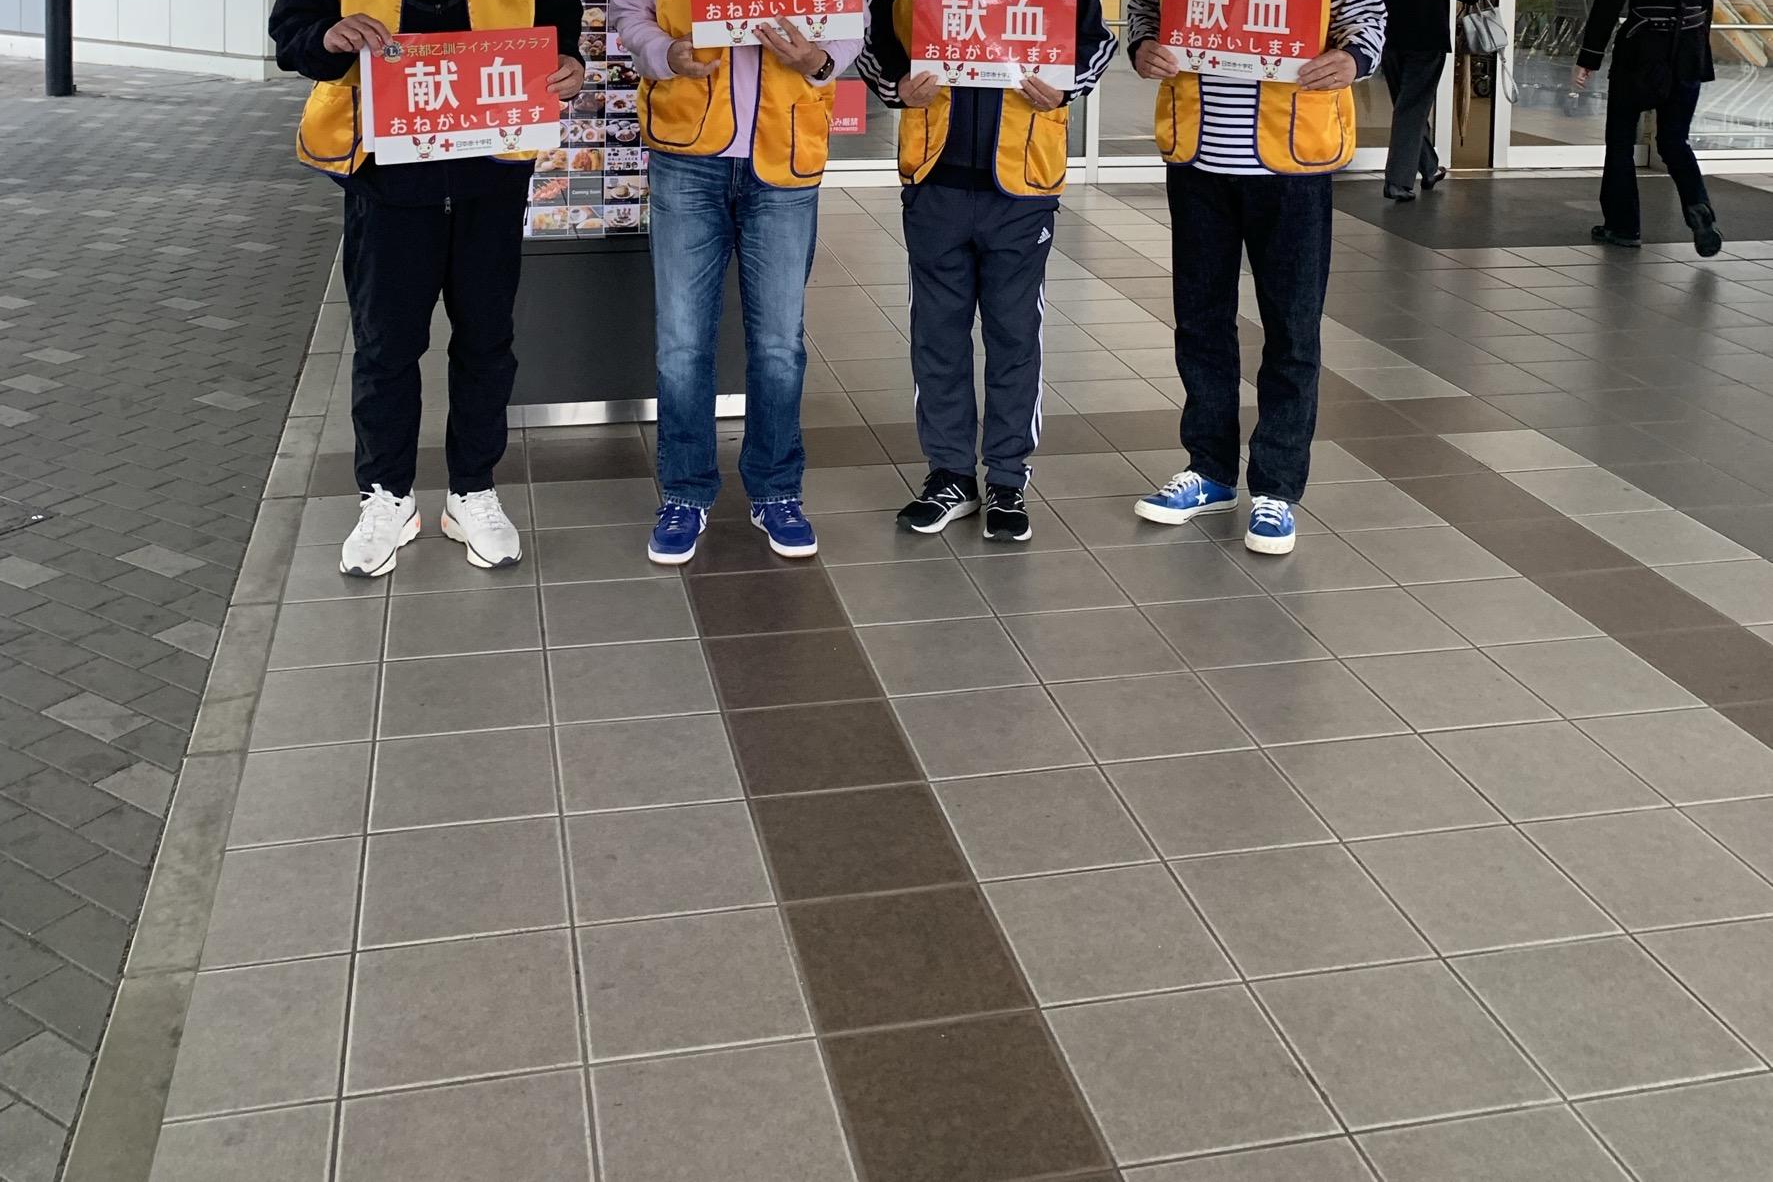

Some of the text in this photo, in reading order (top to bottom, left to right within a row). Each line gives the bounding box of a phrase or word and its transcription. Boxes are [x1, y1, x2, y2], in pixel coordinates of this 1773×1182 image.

[925, 44, 1061, 62] おねがいします
[1169, 29, 1305, 56] おねがいします
[404, 56, 528, 113] 献血
[390, 105, 545, 136] おねがいします
